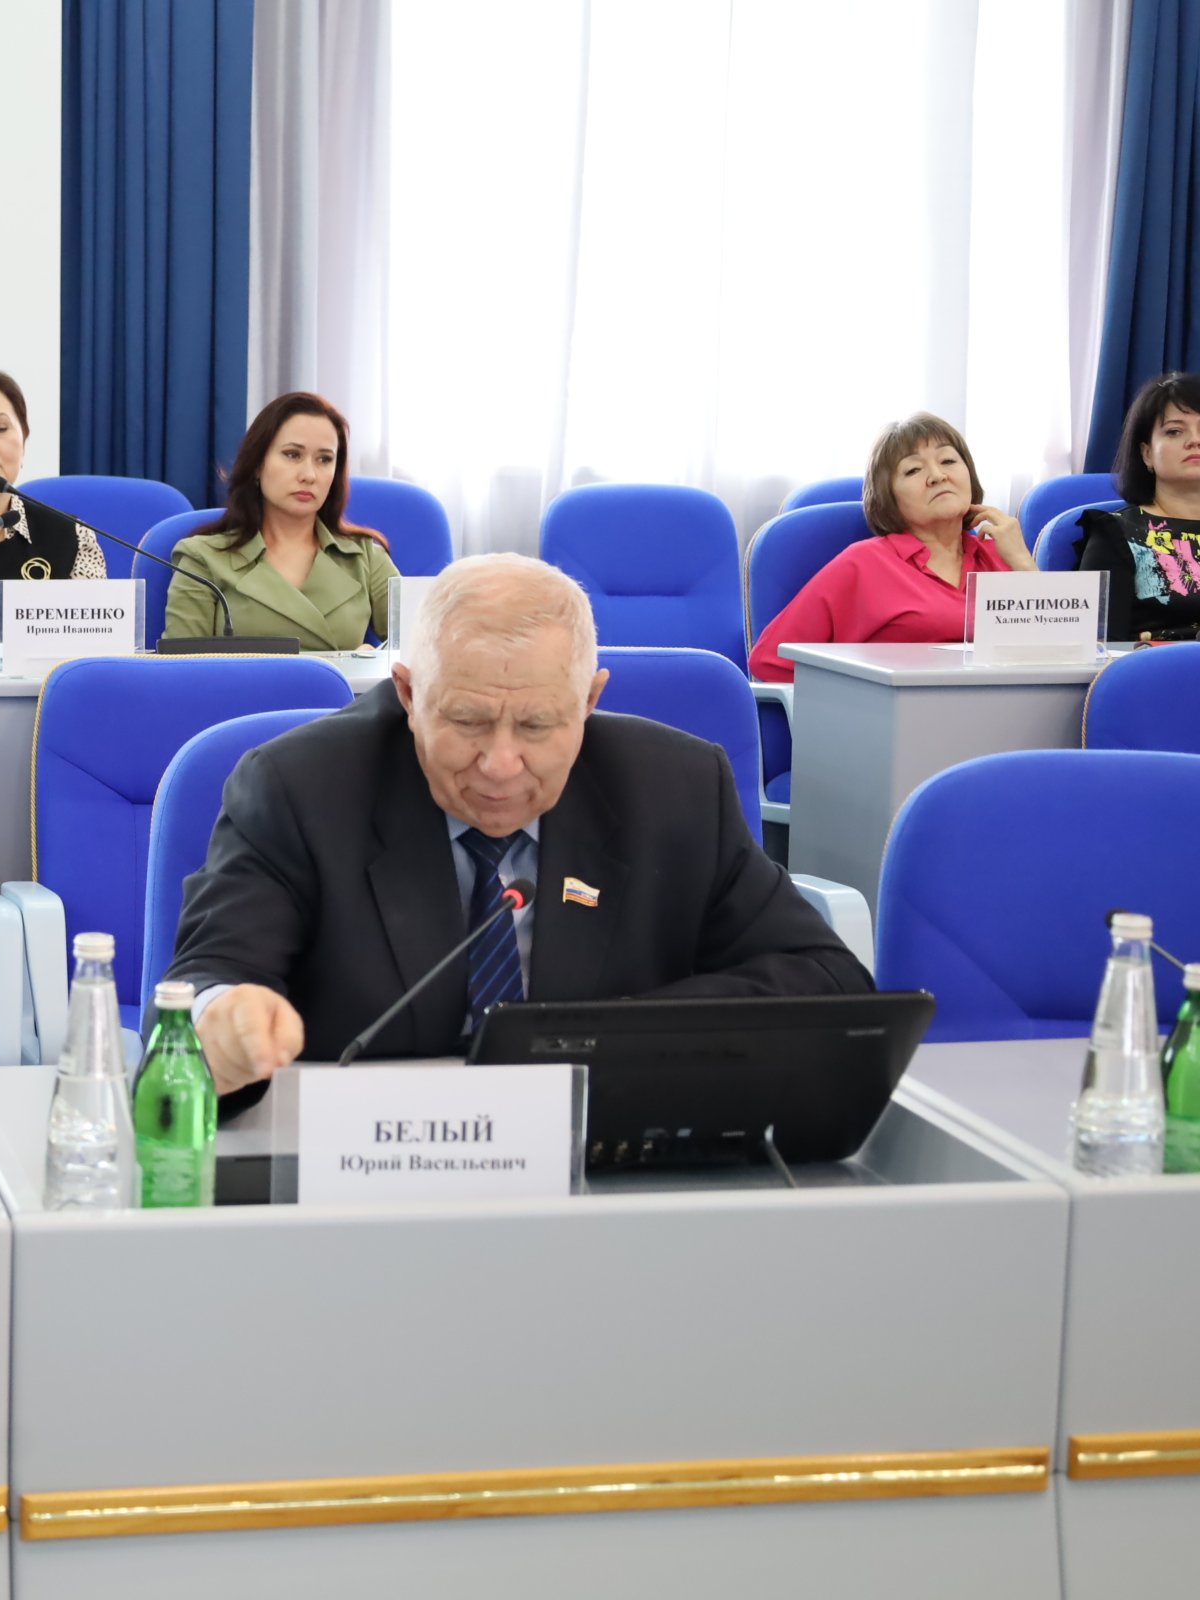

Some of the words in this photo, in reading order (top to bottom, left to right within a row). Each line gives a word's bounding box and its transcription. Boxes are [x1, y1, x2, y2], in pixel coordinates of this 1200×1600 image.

[986, 598, 1090, 611] ИБРАГИМОВА
[15, 608, 125, 620] ВЕРЕМЕЕНКО
[995, 615, 1031, 625] Халиме
[1033, 615, 1080, 625] Мусаевна
[26, 625, 60, 635] Ирина
[62, 625, 113, 634] Ивановна
[374, 1114, 494, 1143] БЕЛЫЙ
[340, 1154, 402, 1175] Юрий
[408, 1154, 526, 1171] Васильевич
